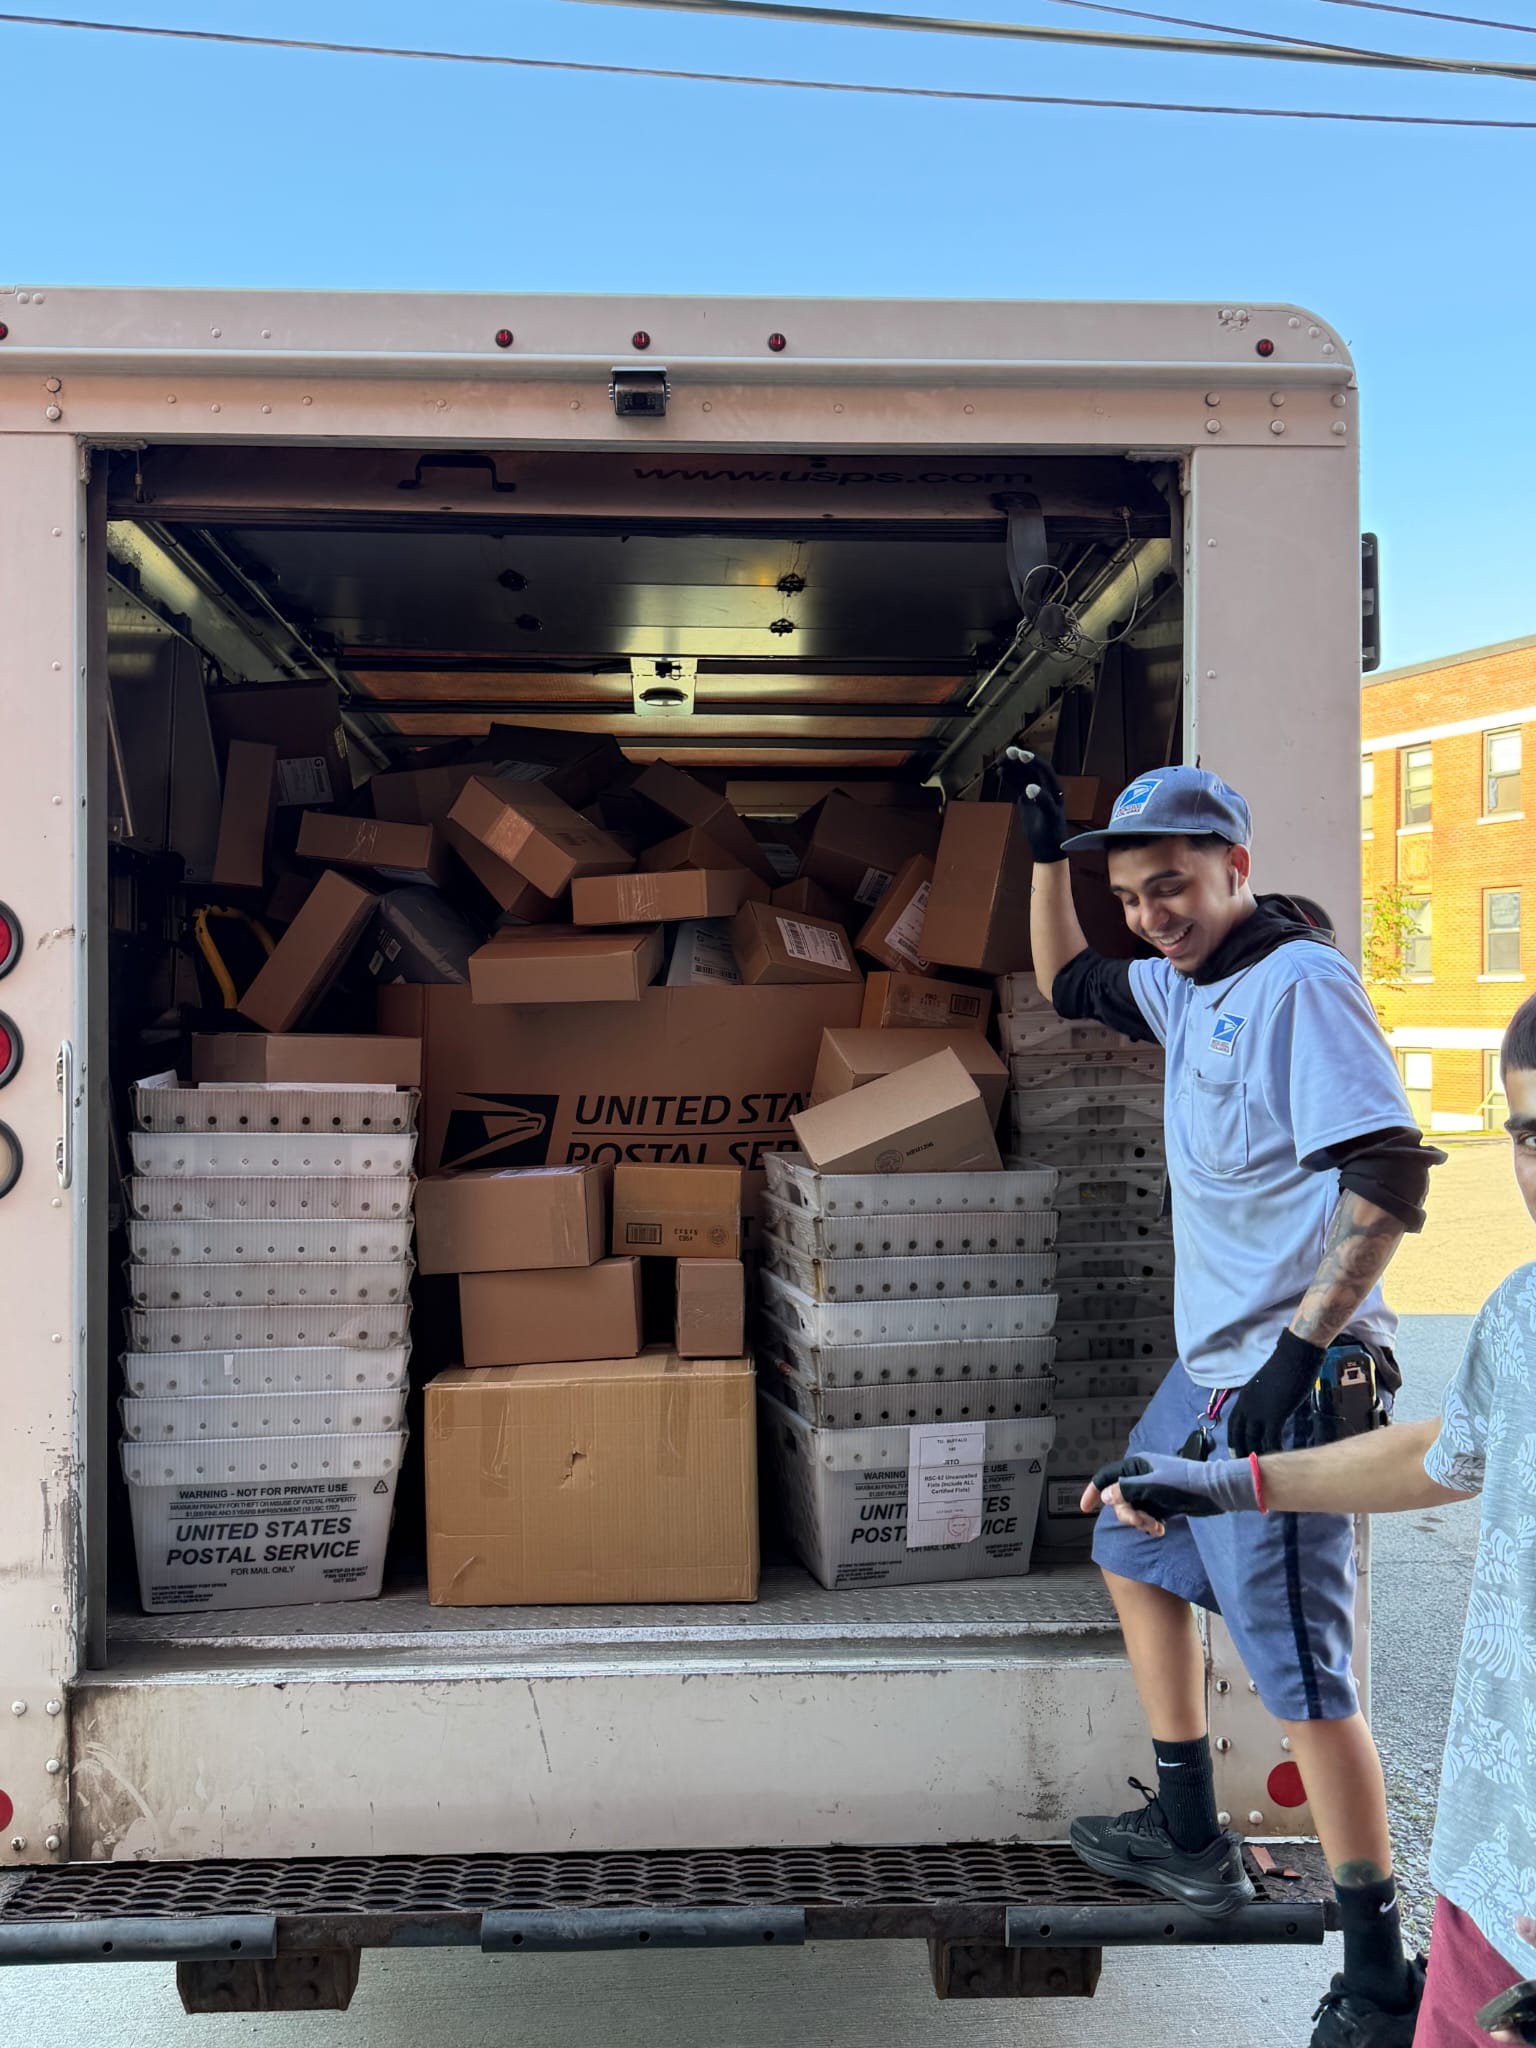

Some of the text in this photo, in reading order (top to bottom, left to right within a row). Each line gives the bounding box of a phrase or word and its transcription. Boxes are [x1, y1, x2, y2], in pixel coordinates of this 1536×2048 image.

[632, 468, 1033, 486] www.usps.com
[575, 1092, 811, 1125] UNITED STA
[864, 1471, 906, 1480] WARNING
[991, 1463, 1008, 1473] USE
[179, 1490, 228, 1499] WARNING
[236, 1488, 258, 1497] NOT
[260, 1487, 281, 1496] FOR
[283, 1484, 326, 1495] PRIVATE
[327, 1483, 349, 1493] USE
[199, 1502, 226, 1510] PENALTY
[302, 1497, 324, 1505] POSTAL
[324, 1496, 357, 1504] PROPERTY
[860, 1503, 908, 1521] UNIT
[176, 1517, 352, 1542] UNITED STATES
[850, 1527, 908, 1544] POST
[166, 1540, 360, 1566] POSTAL SERVICE
[231, 1565, 296, 1576] FOR MAIL ONLY
